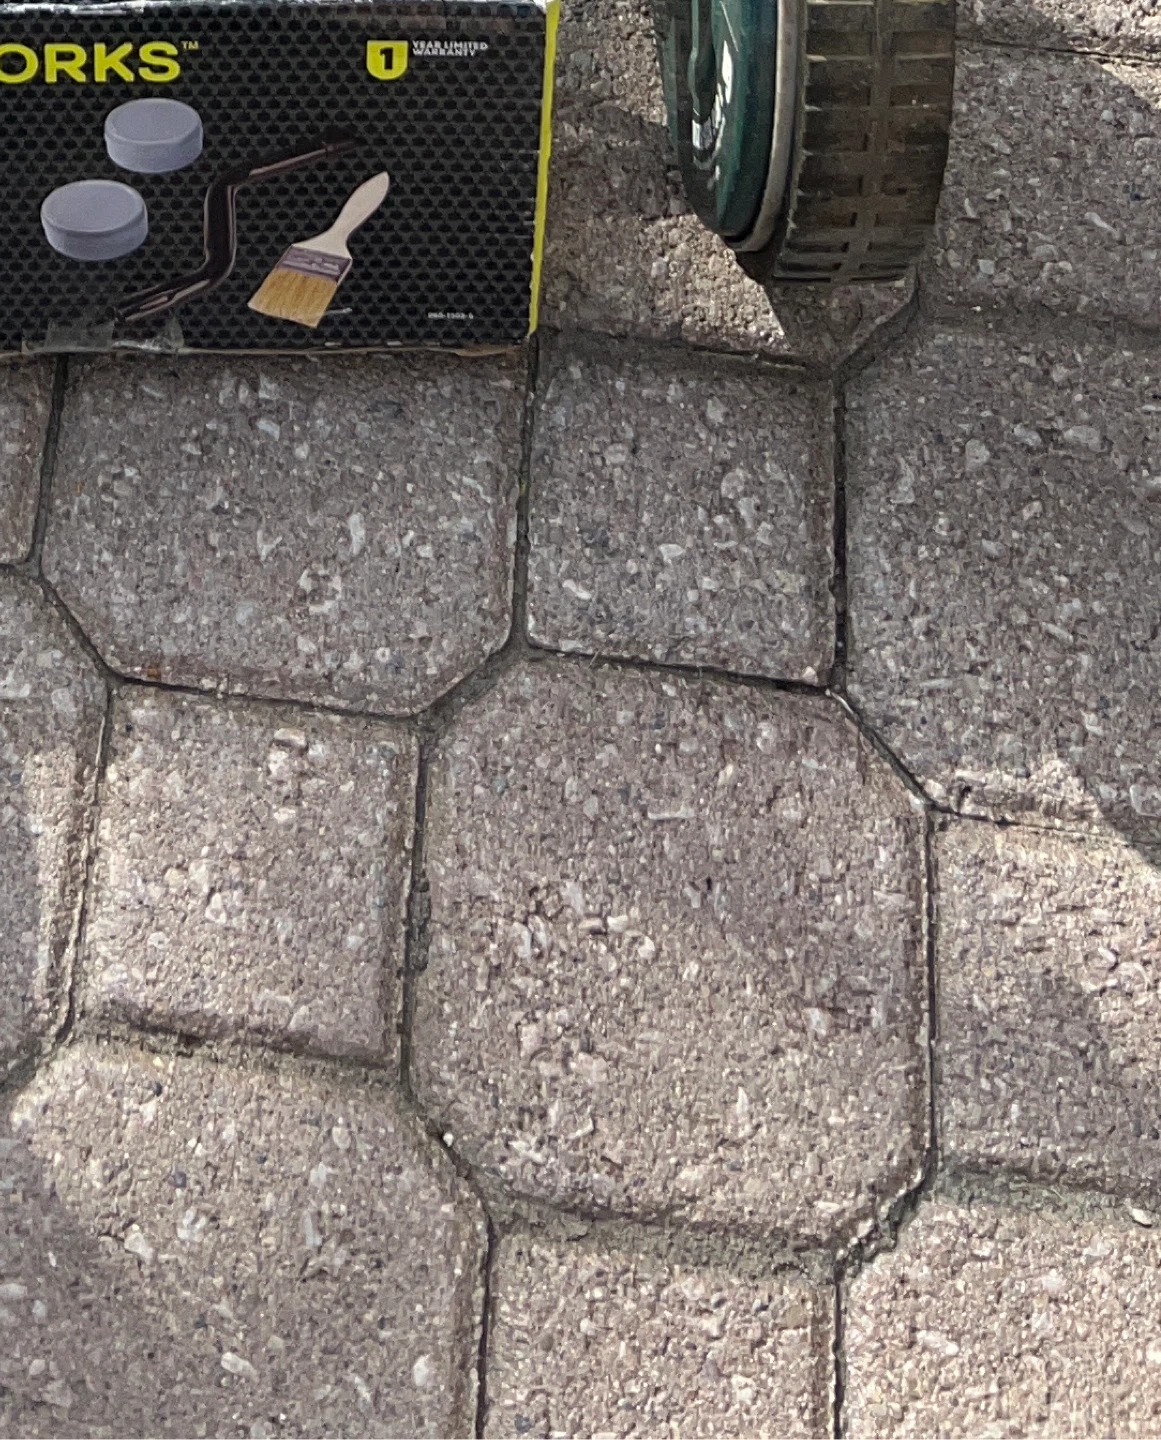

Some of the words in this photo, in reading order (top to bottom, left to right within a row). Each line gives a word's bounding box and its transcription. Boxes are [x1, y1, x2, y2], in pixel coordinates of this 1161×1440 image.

[412, 40, 442, 50] YEAR
[443, 41, 489, 51] LIMITED
[412, 49, 476, 57] WARRANTY
